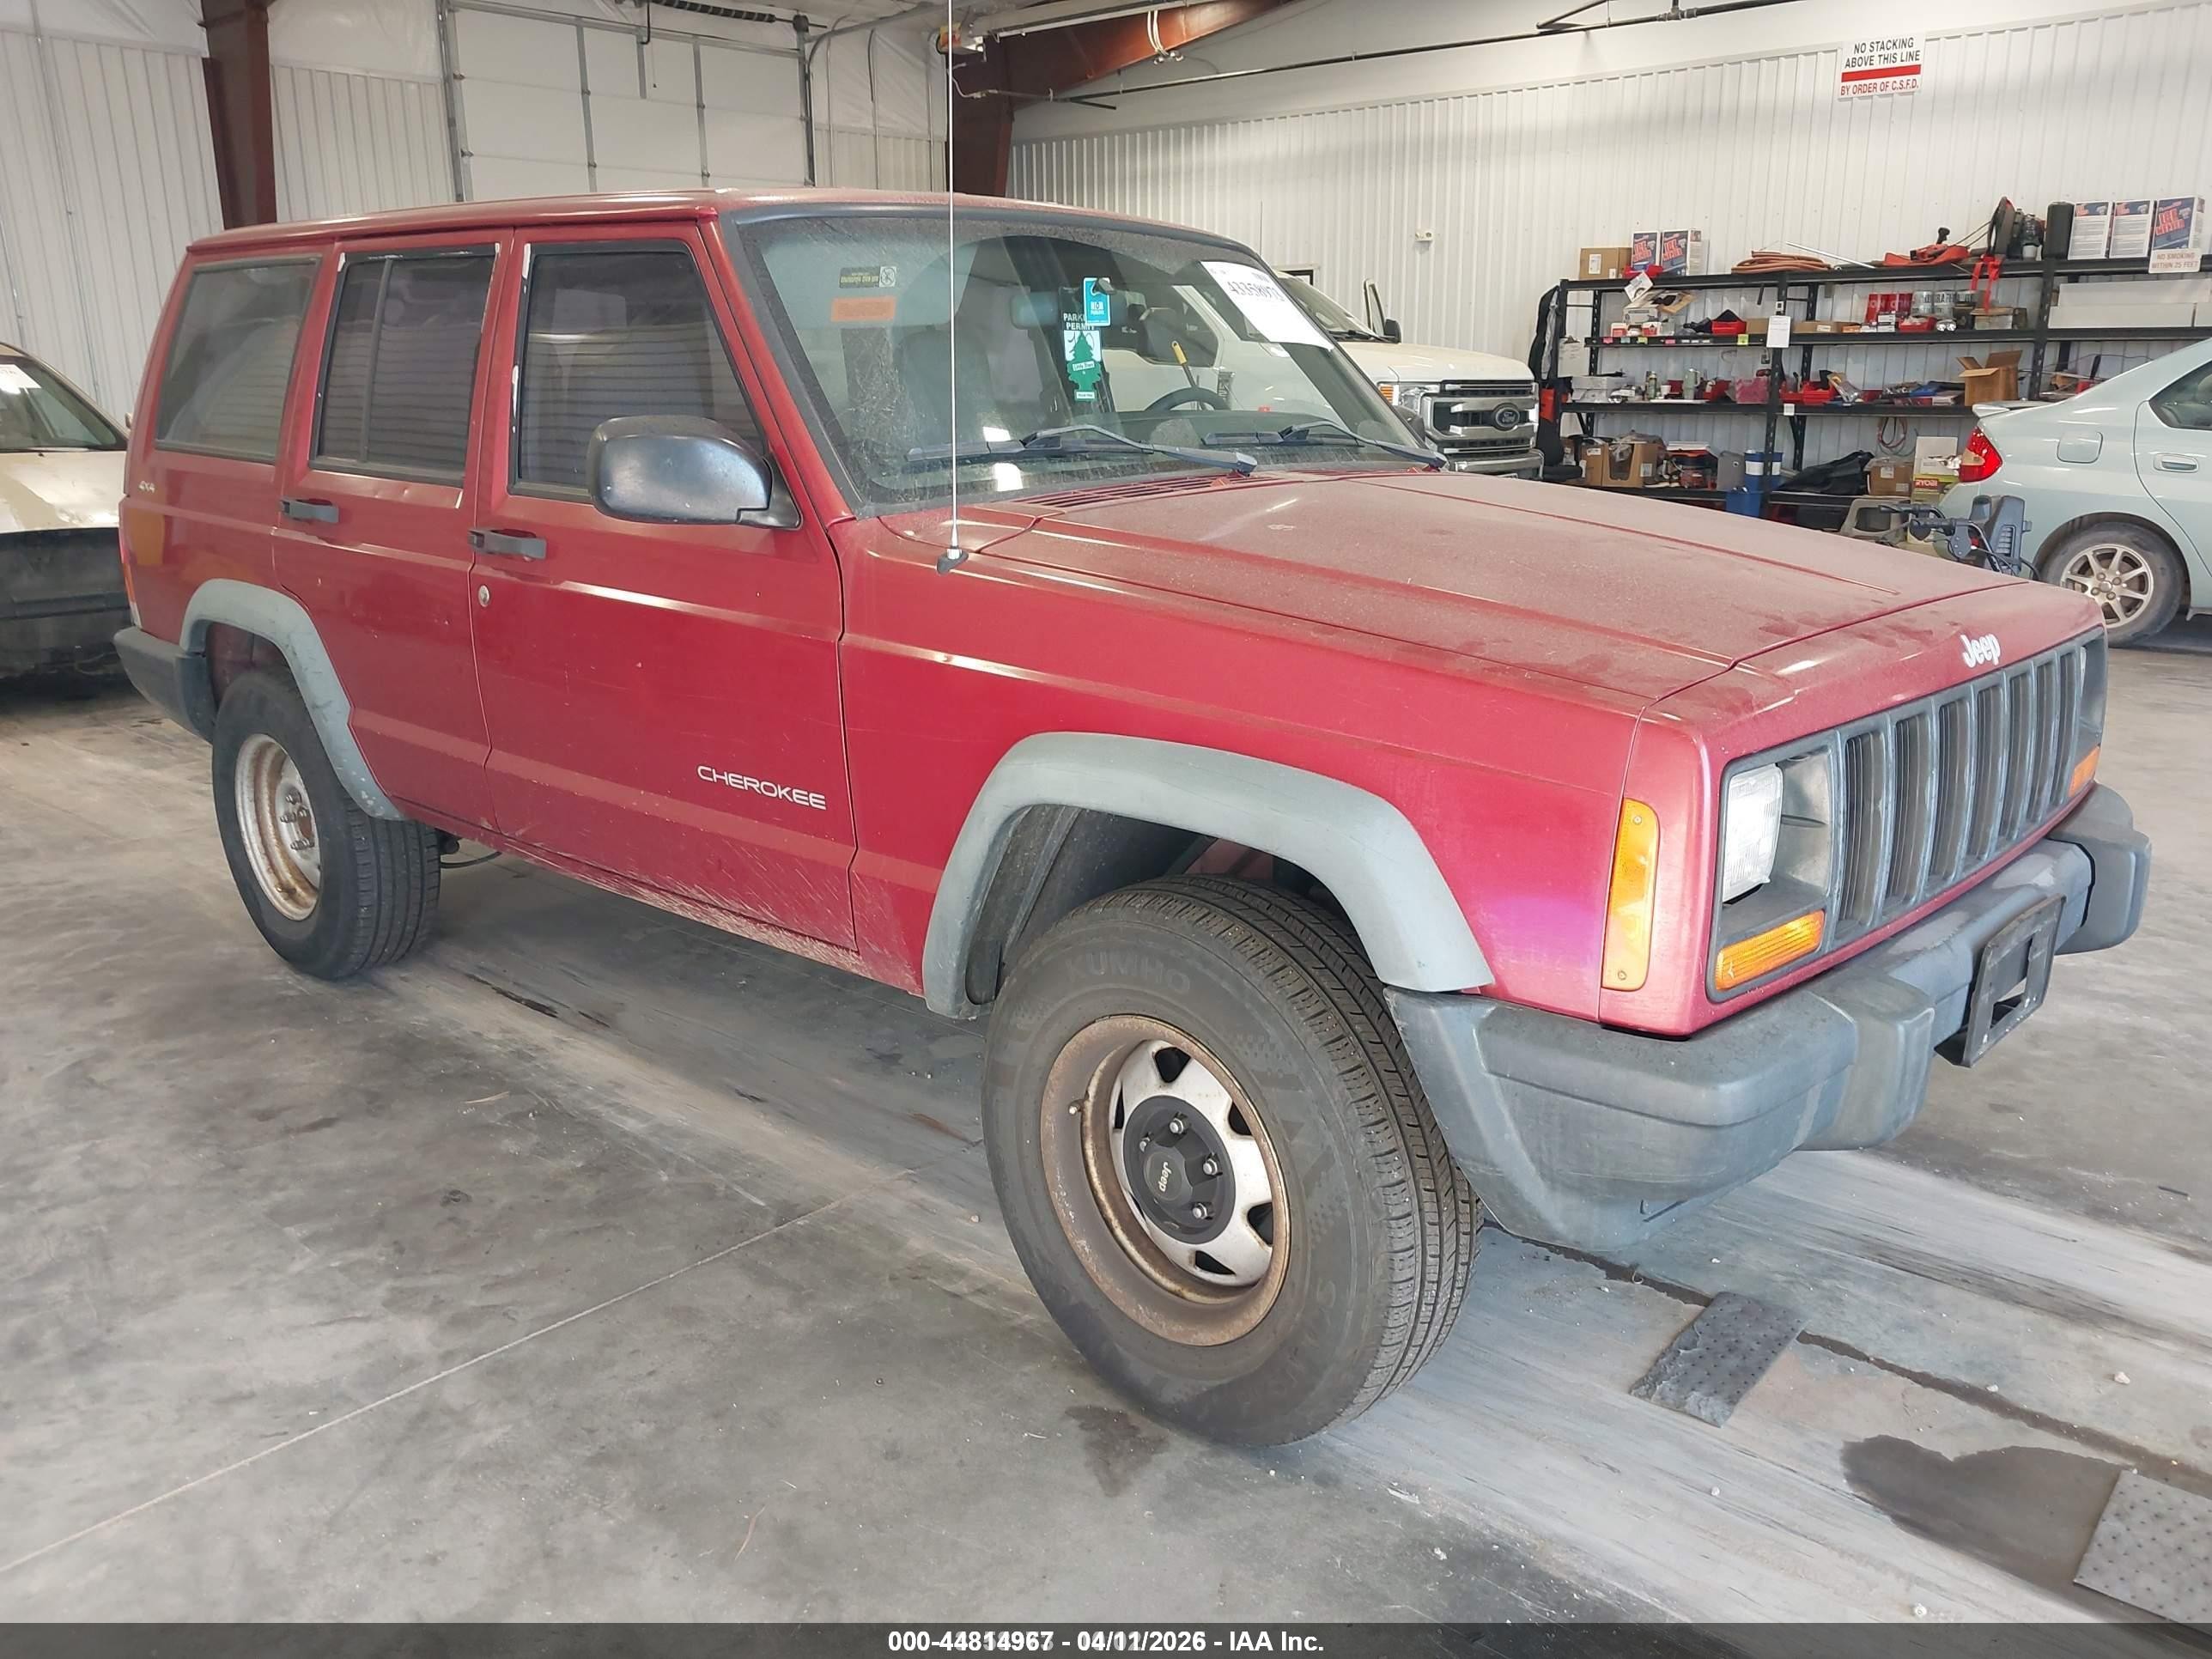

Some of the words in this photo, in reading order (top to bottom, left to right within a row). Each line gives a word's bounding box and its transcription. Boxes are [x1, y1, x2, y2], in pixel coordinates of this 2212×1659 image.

[1854, 42, 1867, 54] NO
[1869, 37, 1914, 52] STACKING
[1845, 55, 1875, 69] ABOVE
[1878, 52, 1898, 65] THIS
[1900, 50, 1920, 62] LINE
[1840, 85, 1851, 96] BY
[1852, 82, 1878, 94] ORDER
[1880, 81, 1890, 92] OF
[1892, 78, 1919, 91] C.S.F.D.
[2152, 261, 2174, 270] WITHIN
[2184, 260, 2199, 269] FEET
[2167, 252, 2195, 260] SMOKING
[1063, 313, 1086, 323] PARKI
[1960, 634, 2001, 668] Jeep
[696, 765, 826, 811] CHEROKEE
[1065, 947, 1190, 994] KUMHO
[1158, 1161, 1172, 1192] Jeep
